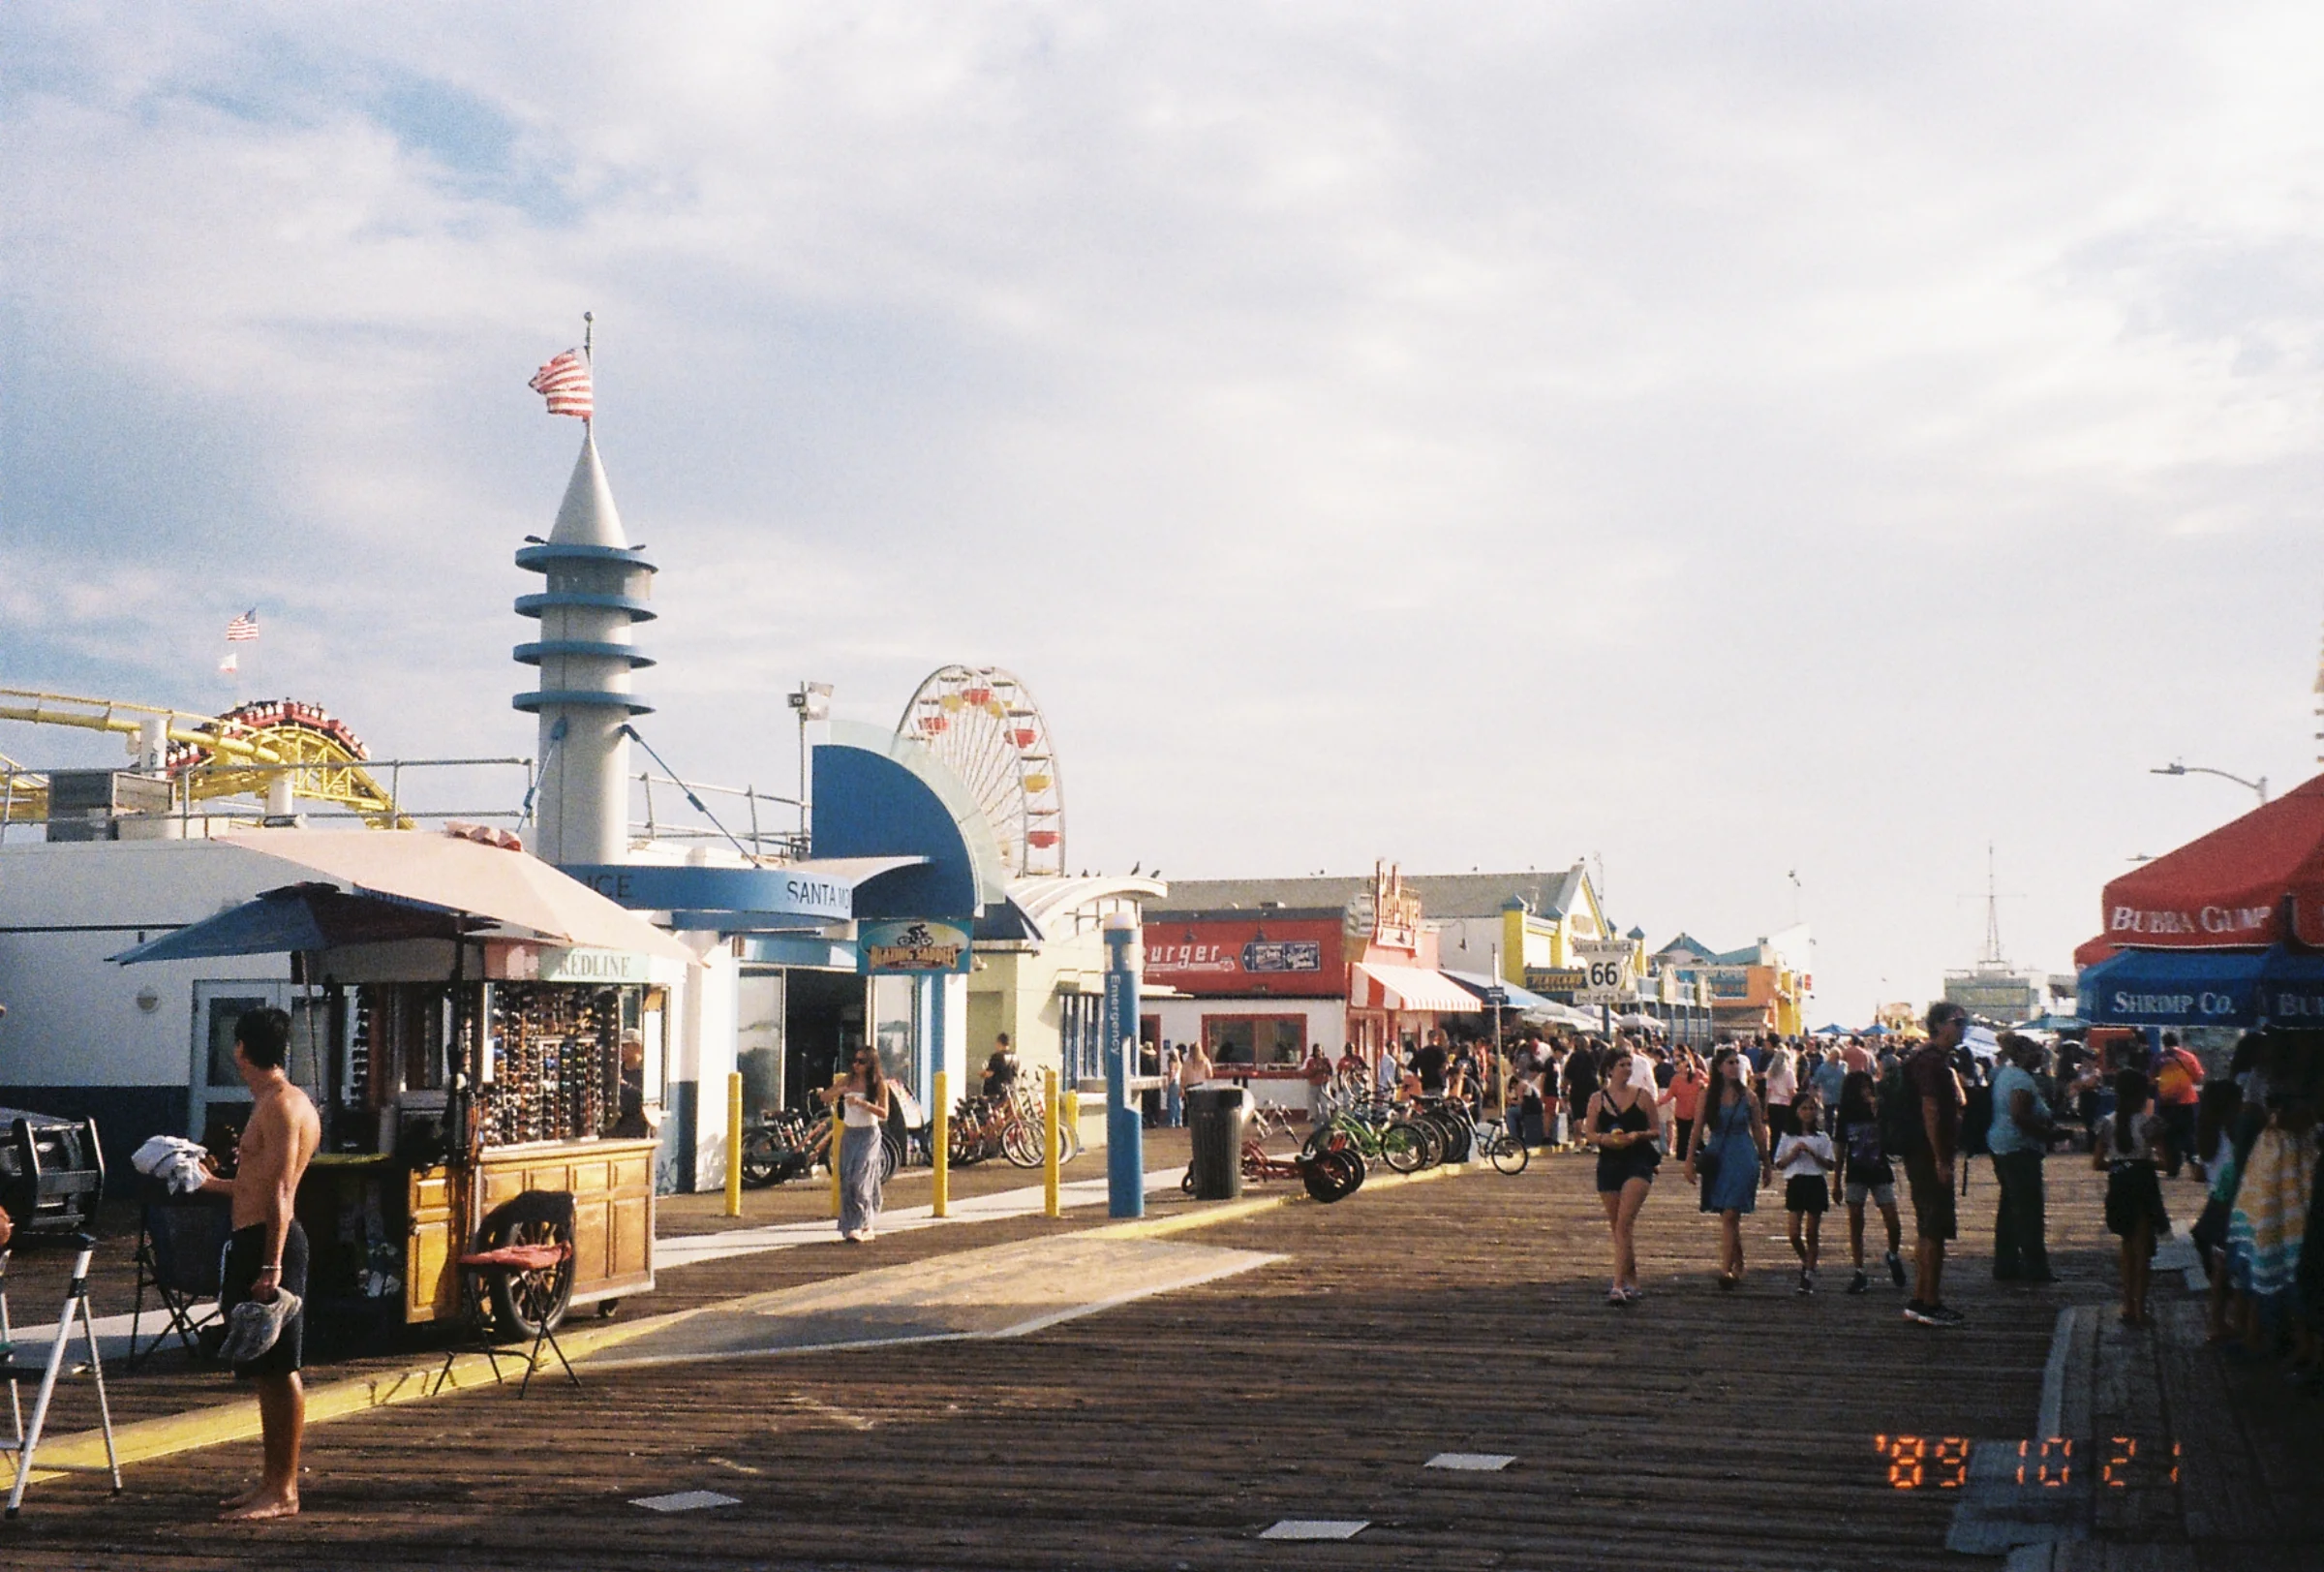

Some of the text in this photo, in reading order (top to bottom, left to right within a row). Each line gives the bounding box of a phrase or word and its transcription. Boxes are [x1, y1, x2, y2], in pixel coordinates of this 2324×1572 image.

[786, 879, 837, 907] SANTA
[2200, 905, 2272, 934] GUMP
[559, 953, 631, 978] REDLINE
[1147, 944, 1220, 970] urger
[1591, 961, 1618, 987] 66
[1109, 973, 1121, 1056] Emergency
